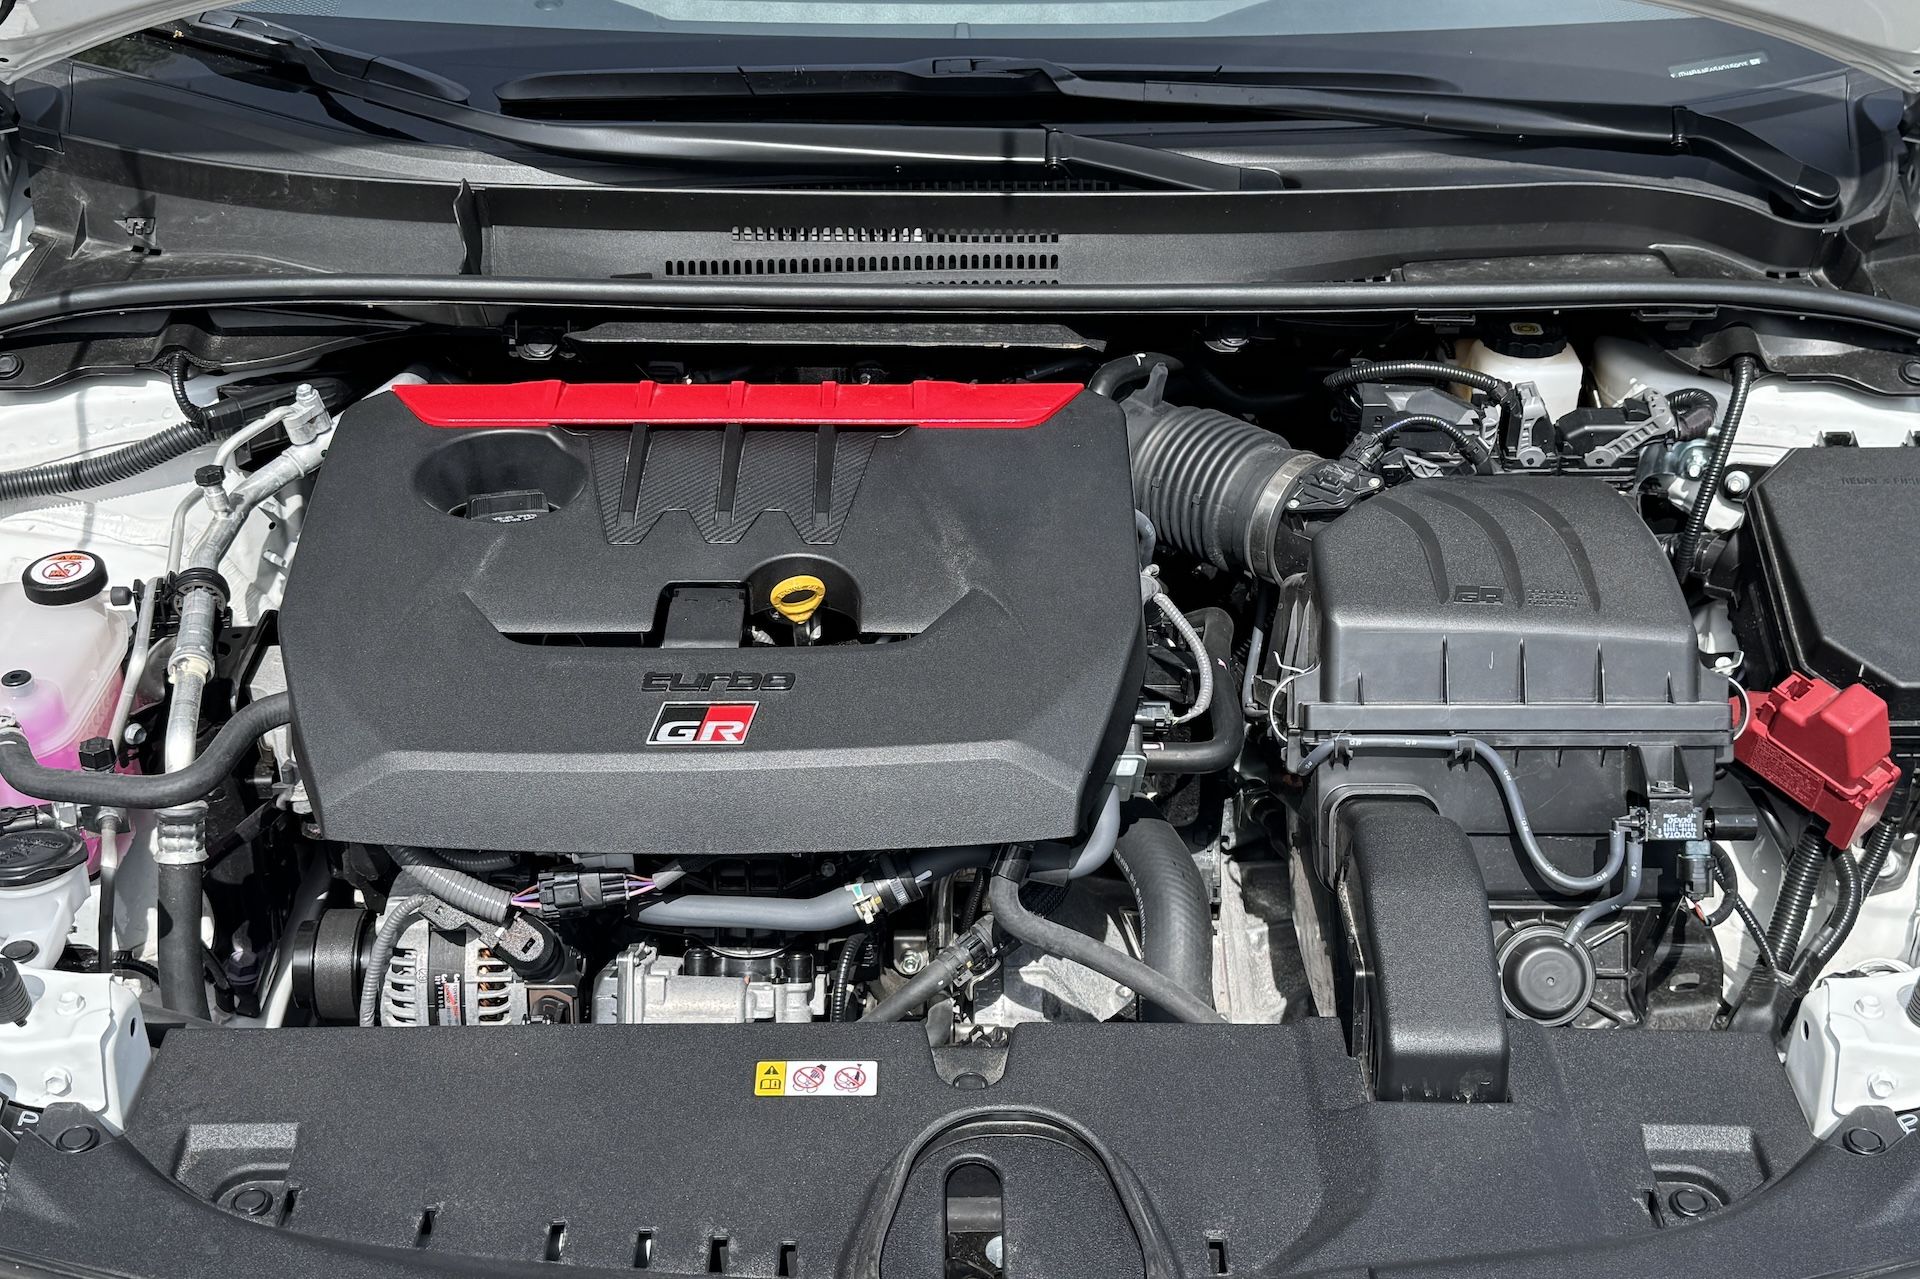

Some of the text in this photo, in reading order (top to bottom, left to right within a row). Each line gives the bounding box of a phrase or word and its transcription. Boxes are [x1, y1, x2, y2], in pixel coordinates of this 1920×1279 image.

[641, 671, 796, 692] turbo
[656, 720, 745, 742] GR
[1663, 831, 1697, 839] TOYOTA
